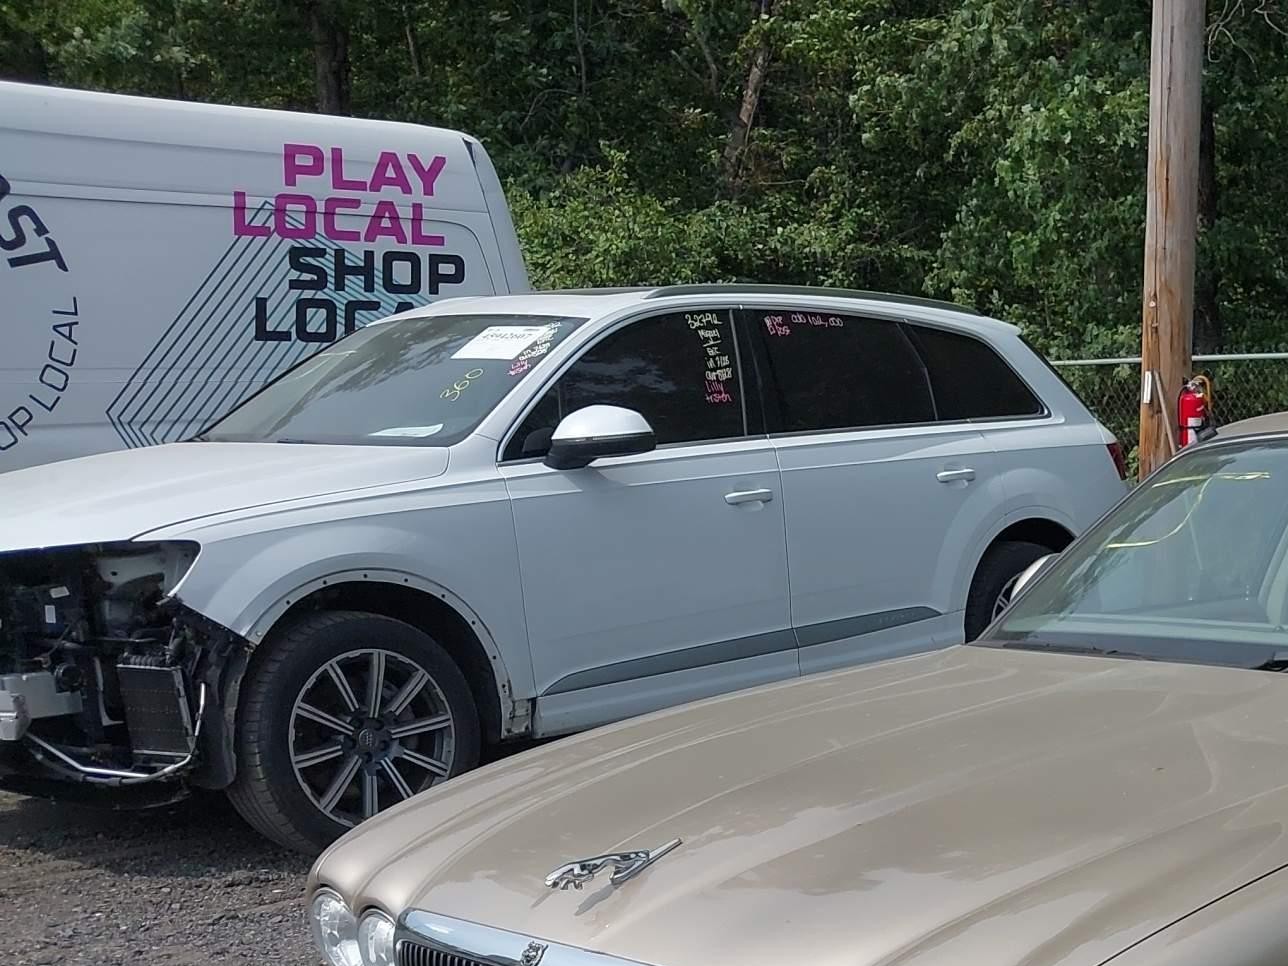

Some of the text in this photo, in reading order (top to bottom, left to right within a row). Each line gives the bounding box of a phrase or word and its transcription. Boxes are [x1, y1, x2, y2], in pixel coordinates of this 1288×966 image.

[284, 143, 446, 197] PLAY
[0, 174, 69, 273] ST
[233, 191, 446, 247] LOCAL
[288, 245, 466, 296] SHOP
[254, 297, 415, 343] LOC
[29, 296, 79, 412] LOCAL
[439, 368, 484, 402] 360
